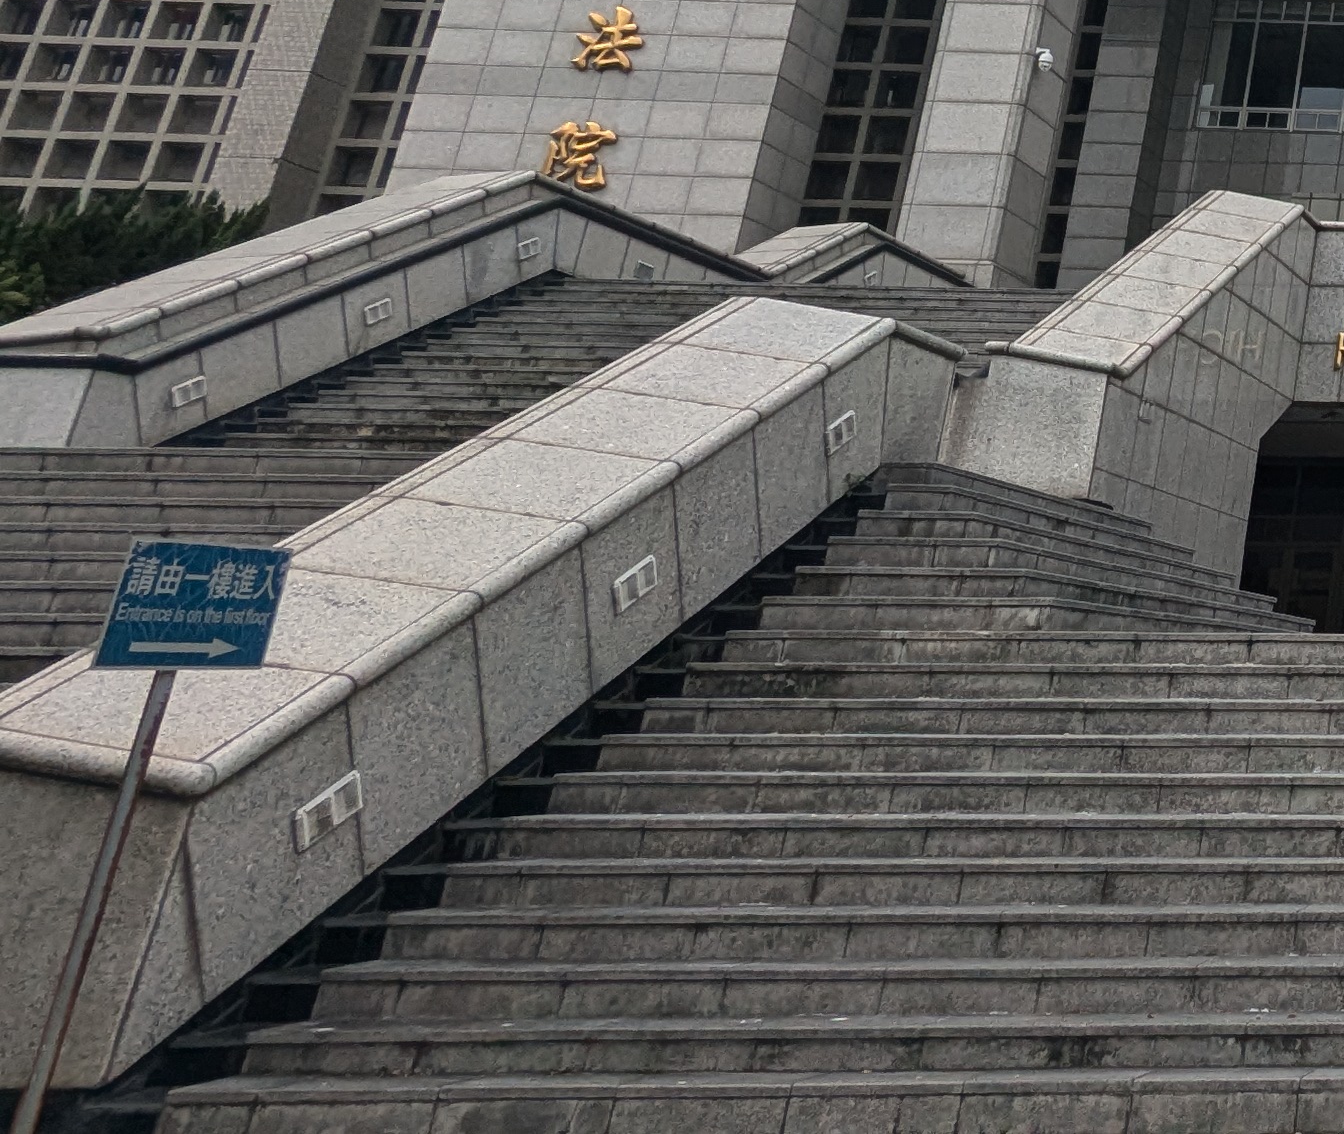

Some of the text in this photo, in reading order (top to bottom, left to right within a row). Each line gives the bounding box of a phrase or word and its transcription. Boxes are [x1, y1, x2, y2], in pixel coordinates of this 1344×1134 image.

[125, 556, 275, 599] 請由一樓進入
[115, 602, 173, 622] Entrance
[187, 609, 202, 623] on
[203, 606, 222, 624] the
[224, 607, 244, 624] first
[245, 609, 270, 625] floor
